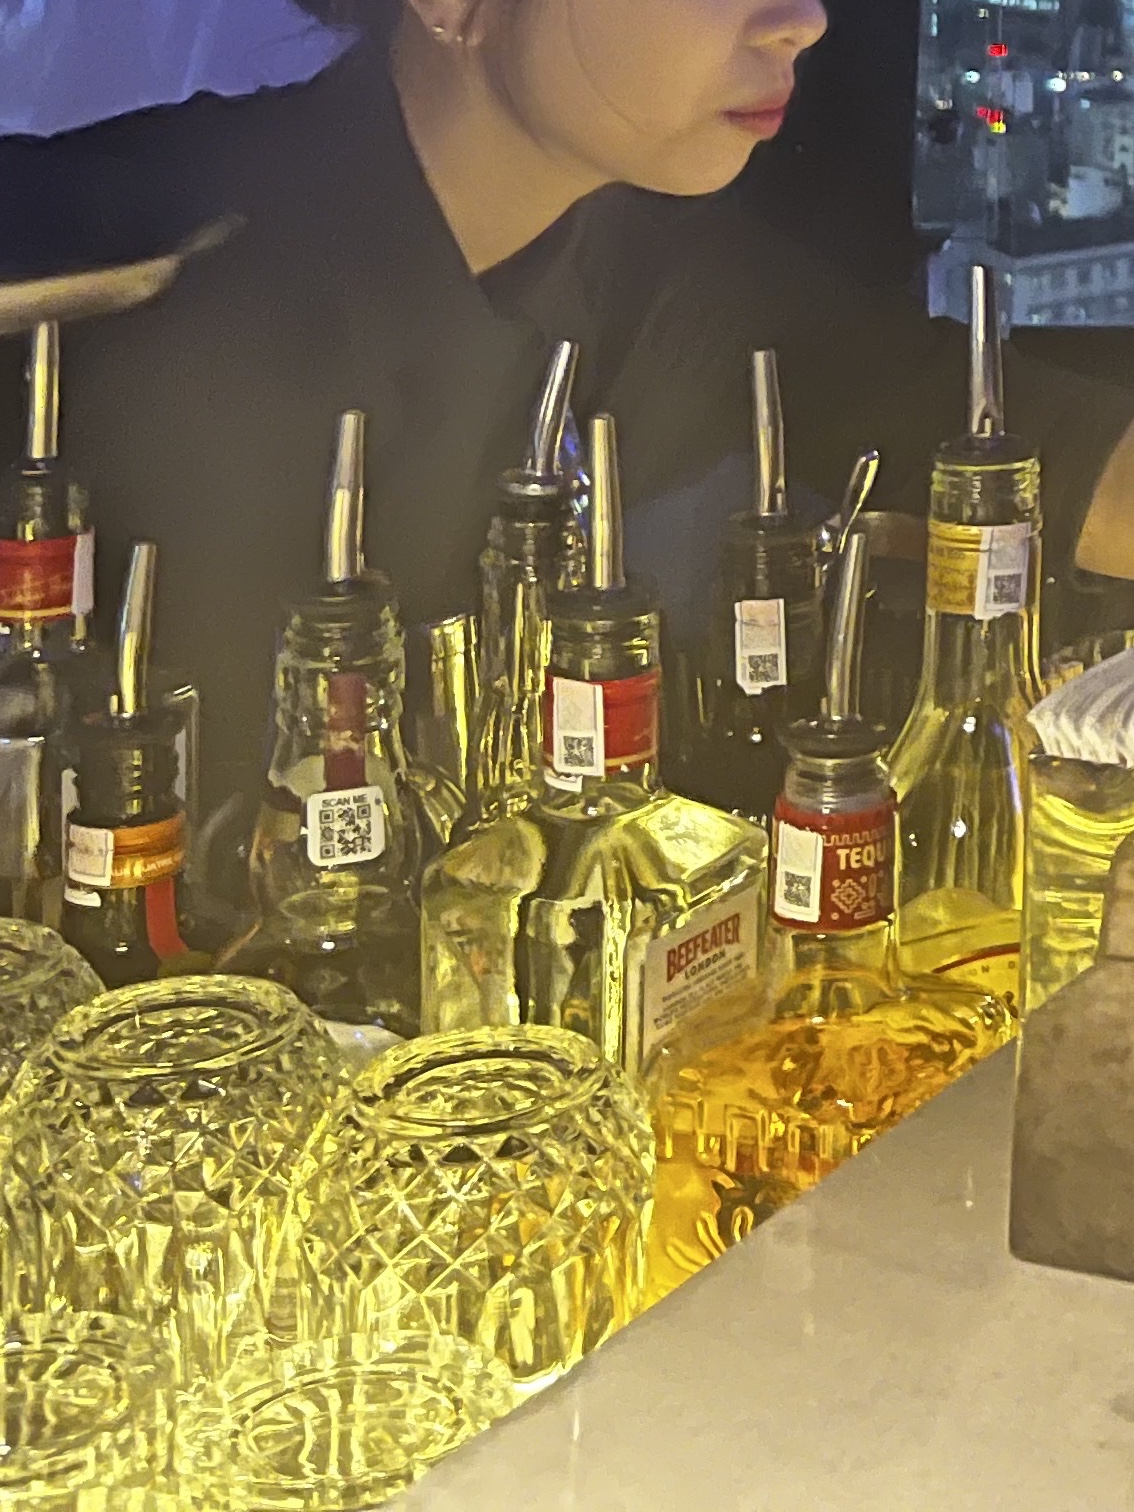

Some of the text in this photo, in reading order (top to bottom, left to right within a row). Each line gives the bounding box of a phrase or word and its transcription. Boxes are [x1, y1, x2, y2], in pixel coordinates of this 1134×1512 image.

[322, 796, 350, 808] SCAN
[836, 839, 887, 870] TEQU
[666, 912, 740, 983] BEEFEATER
[684, 948, 726, 980] LONDON
